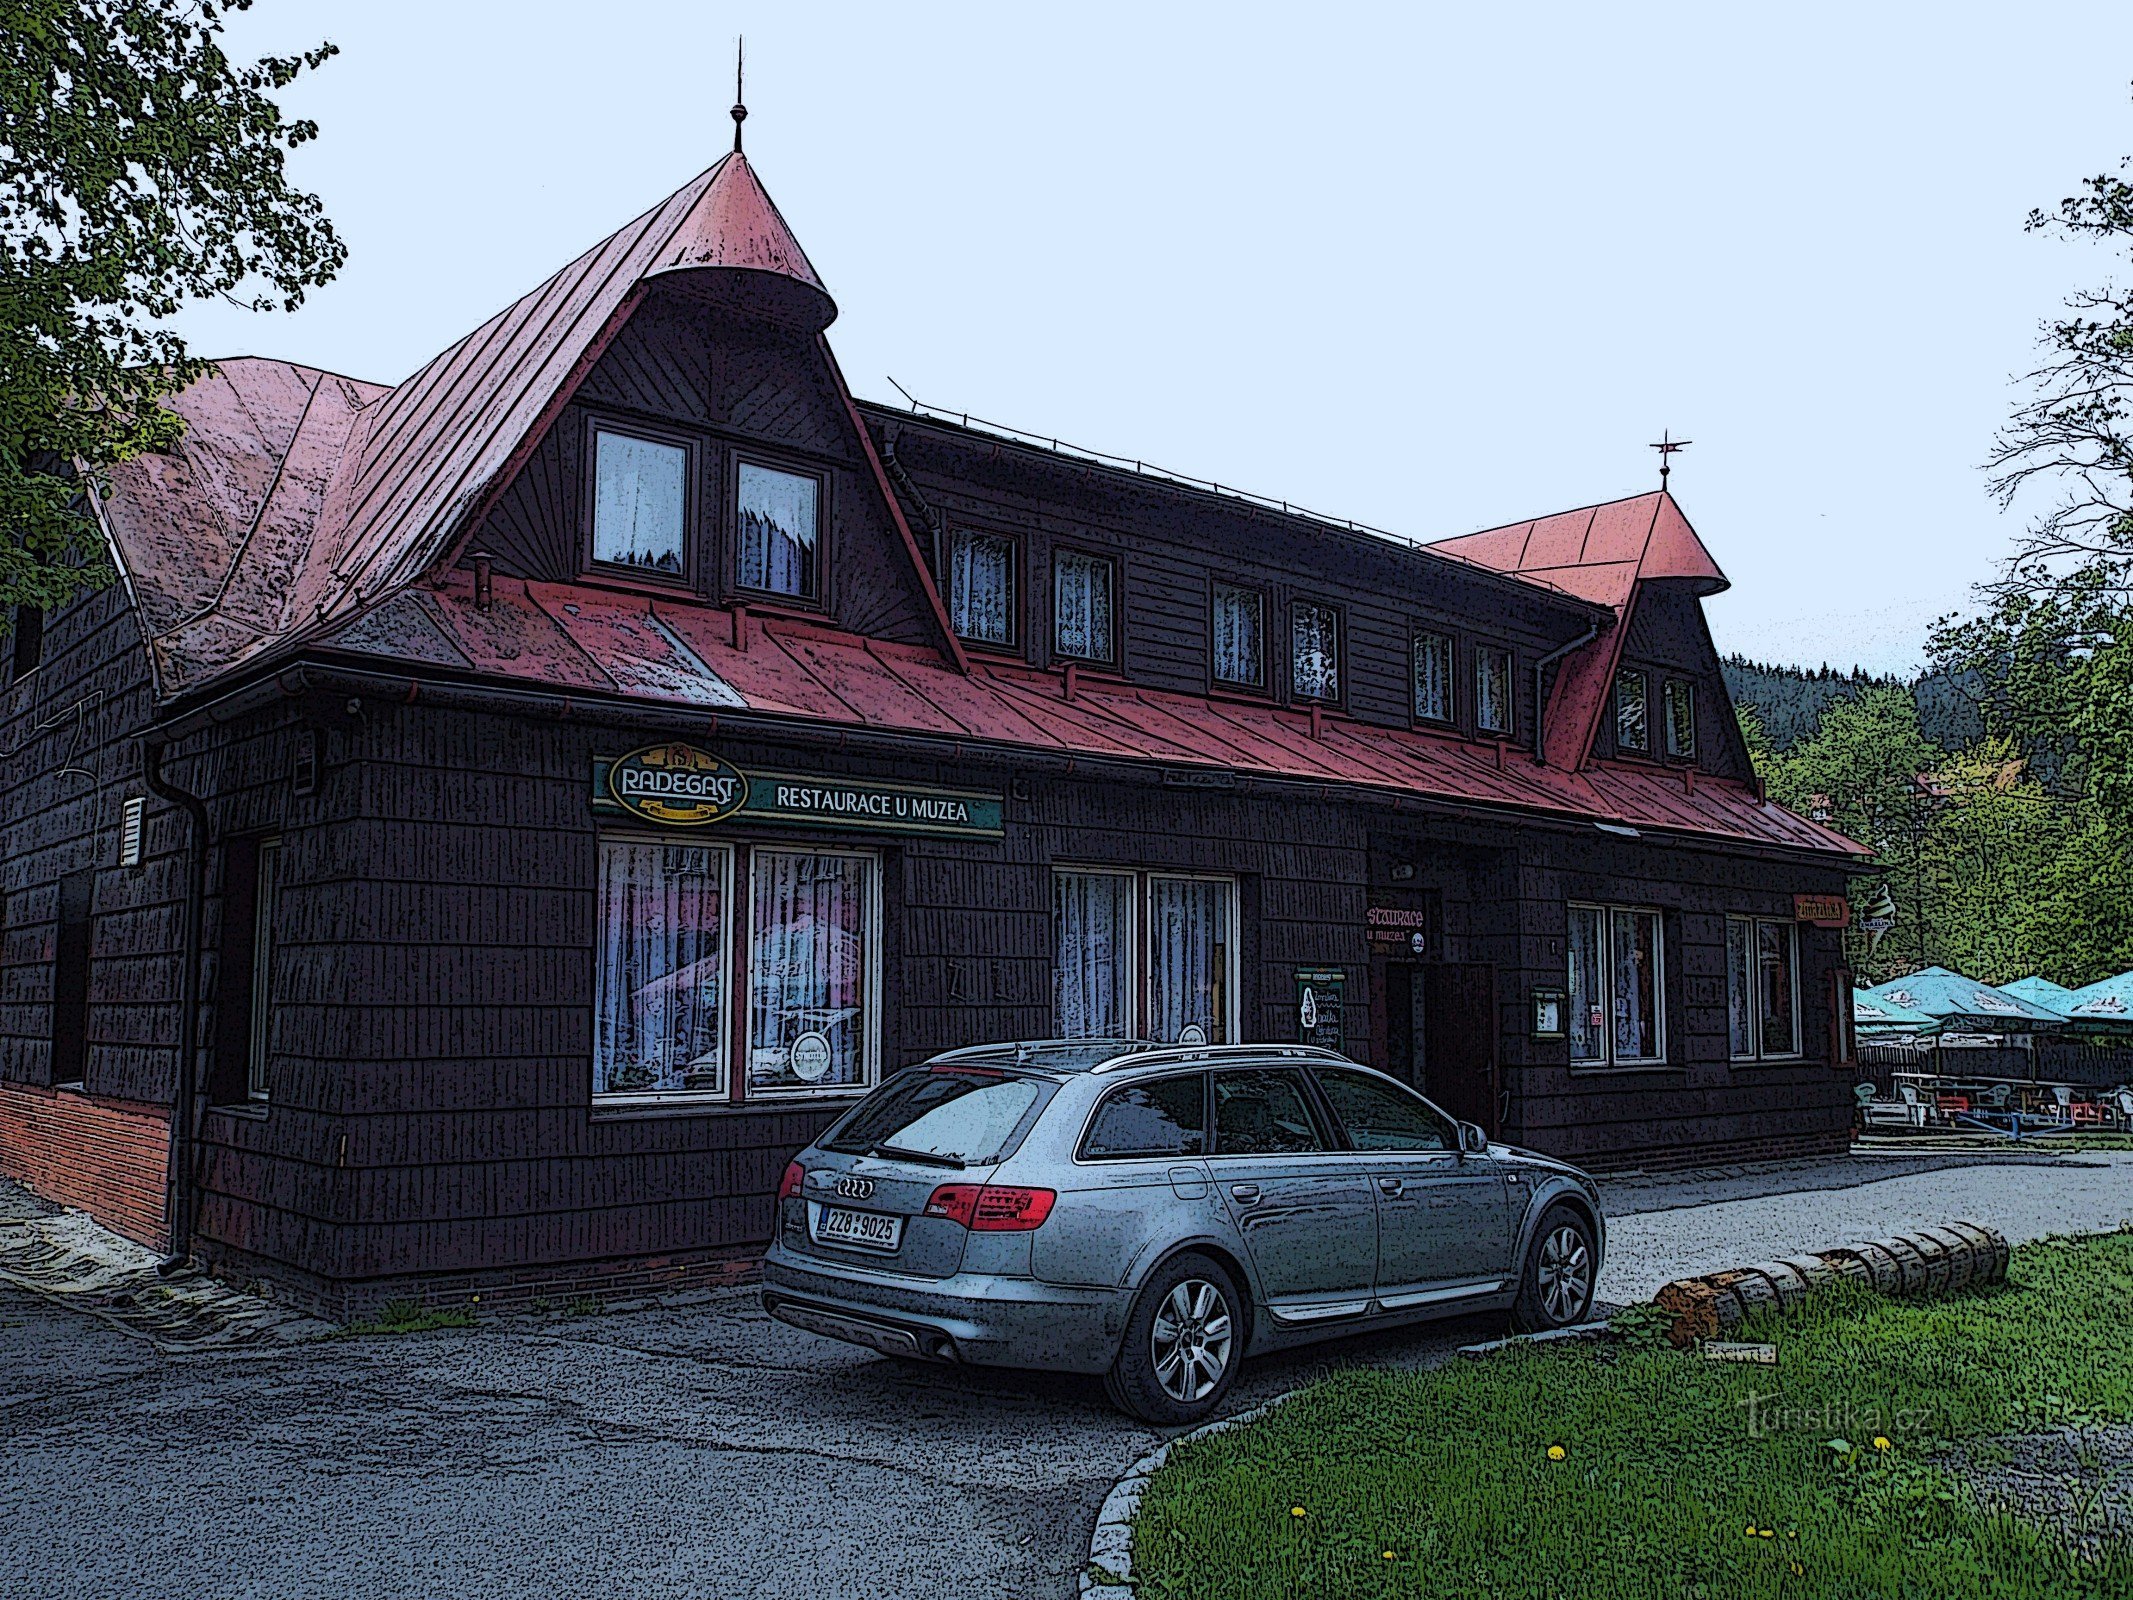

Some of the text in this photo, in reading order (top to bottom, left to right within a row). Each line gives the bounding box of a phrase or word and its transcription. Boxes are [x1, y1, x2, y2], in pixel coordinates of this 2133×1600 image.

[622, 768, 737, 804] RADEGAST
[777, 786, 969, 822] RESTAURACE U MUZEA
[828, 1211, 853, 1234] 2Z8
[860, 1216, 895, 1240] 9025
